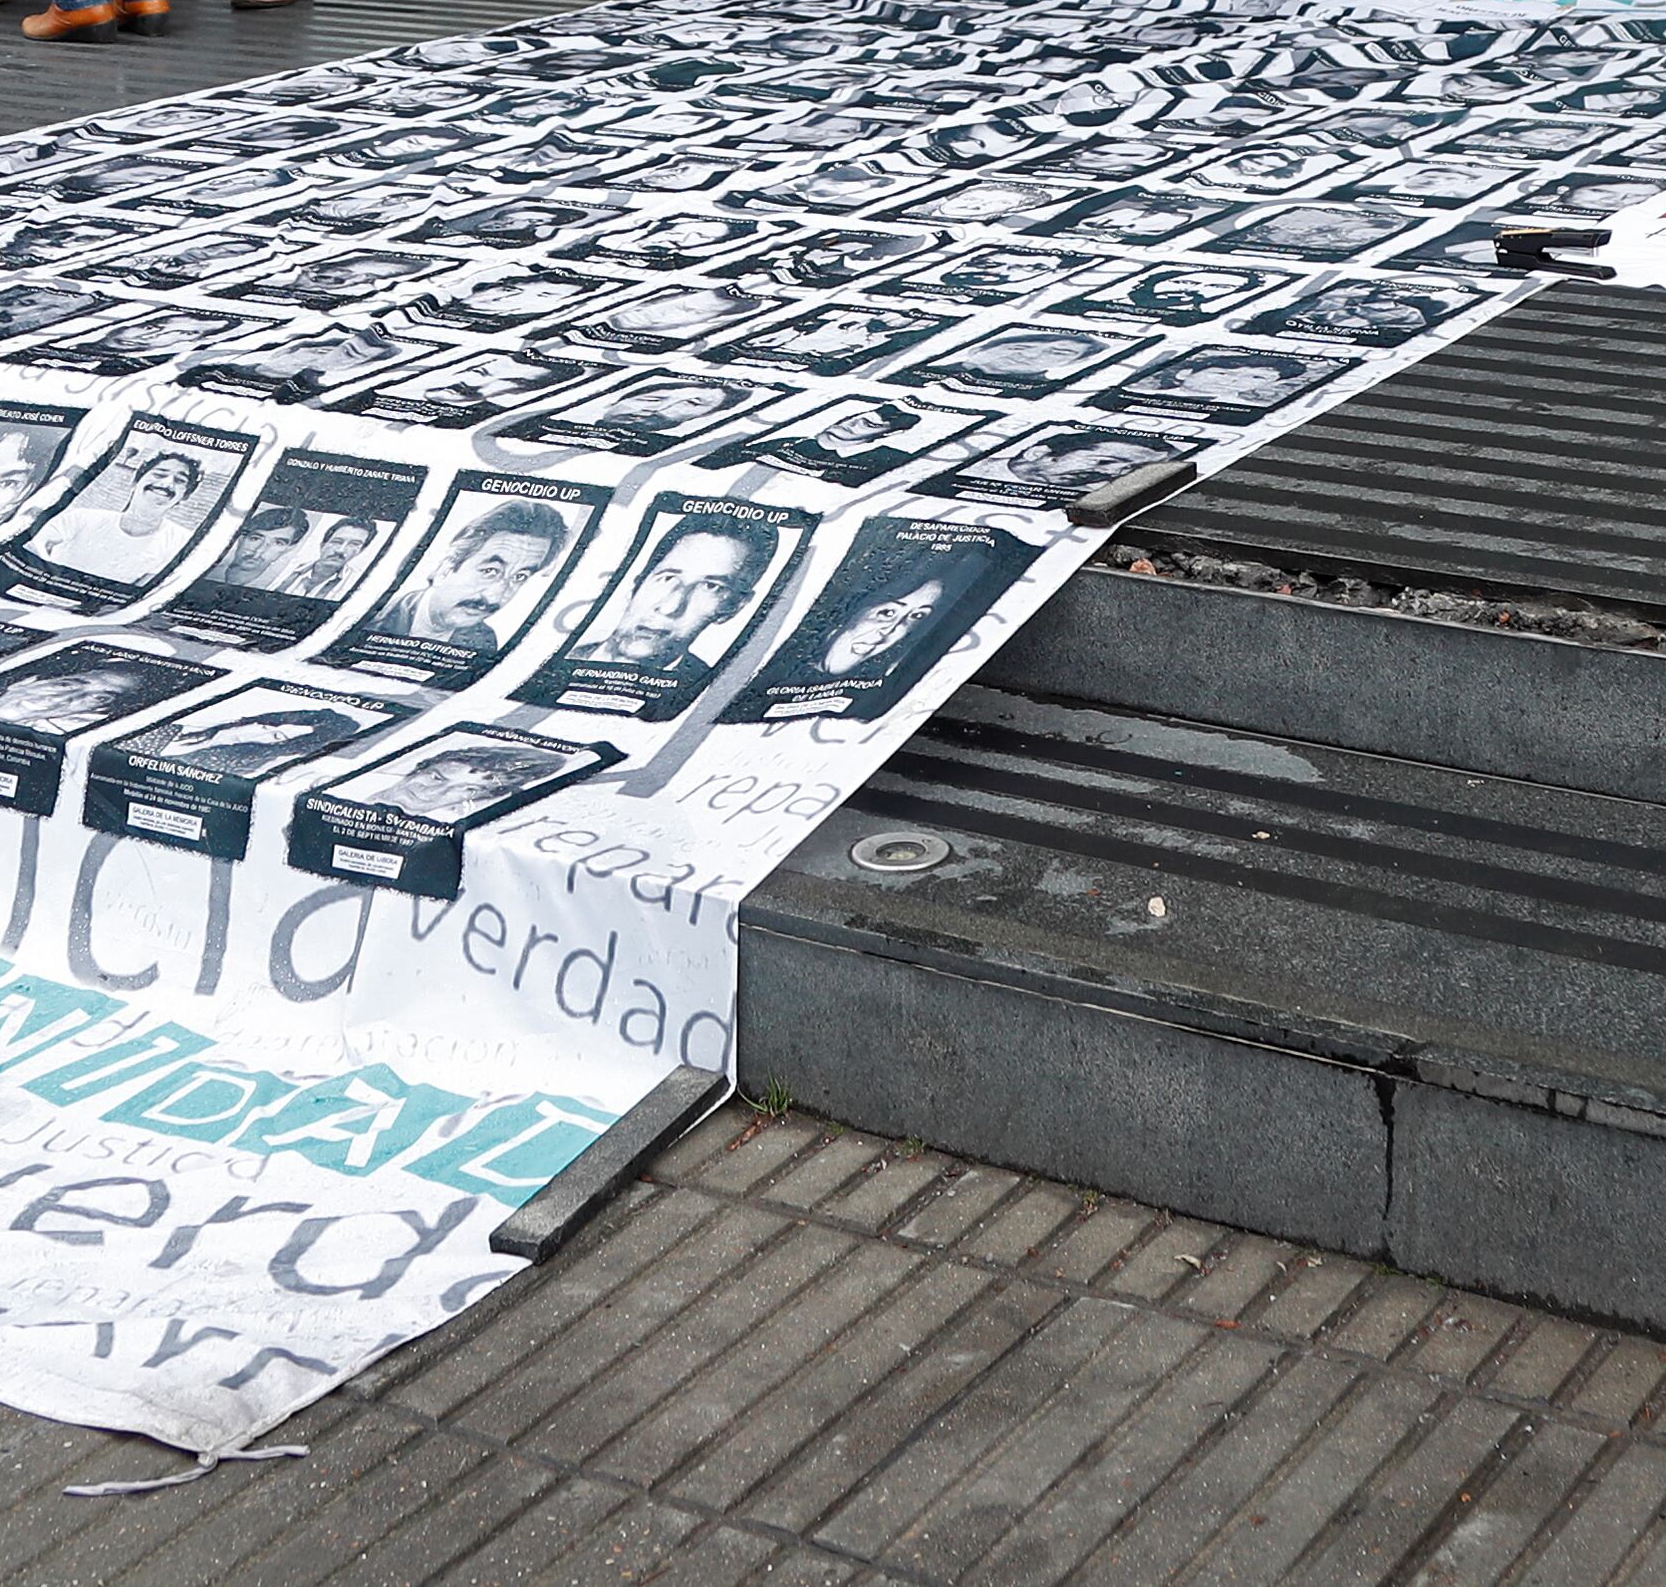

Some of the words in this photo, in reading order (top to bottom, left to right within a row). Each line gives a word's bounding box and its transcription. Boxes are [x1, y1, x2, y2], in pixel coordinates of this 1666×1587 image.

[480, 476, 558, 499] GENOCIDIO
[558, 485, 582, 503] UP
[681, 498, 765, 523] GENOCIDIO
[764, 509, 790, 525] UP
[365, 633, 420, 649] HERNANDO
[128, 754, 177, 775] ORFELINA
[176, 763, 224, 786] SÁNCHEZ
[497, 816, 739, 926] repar
[409, 887, 735, 1075] verdad
